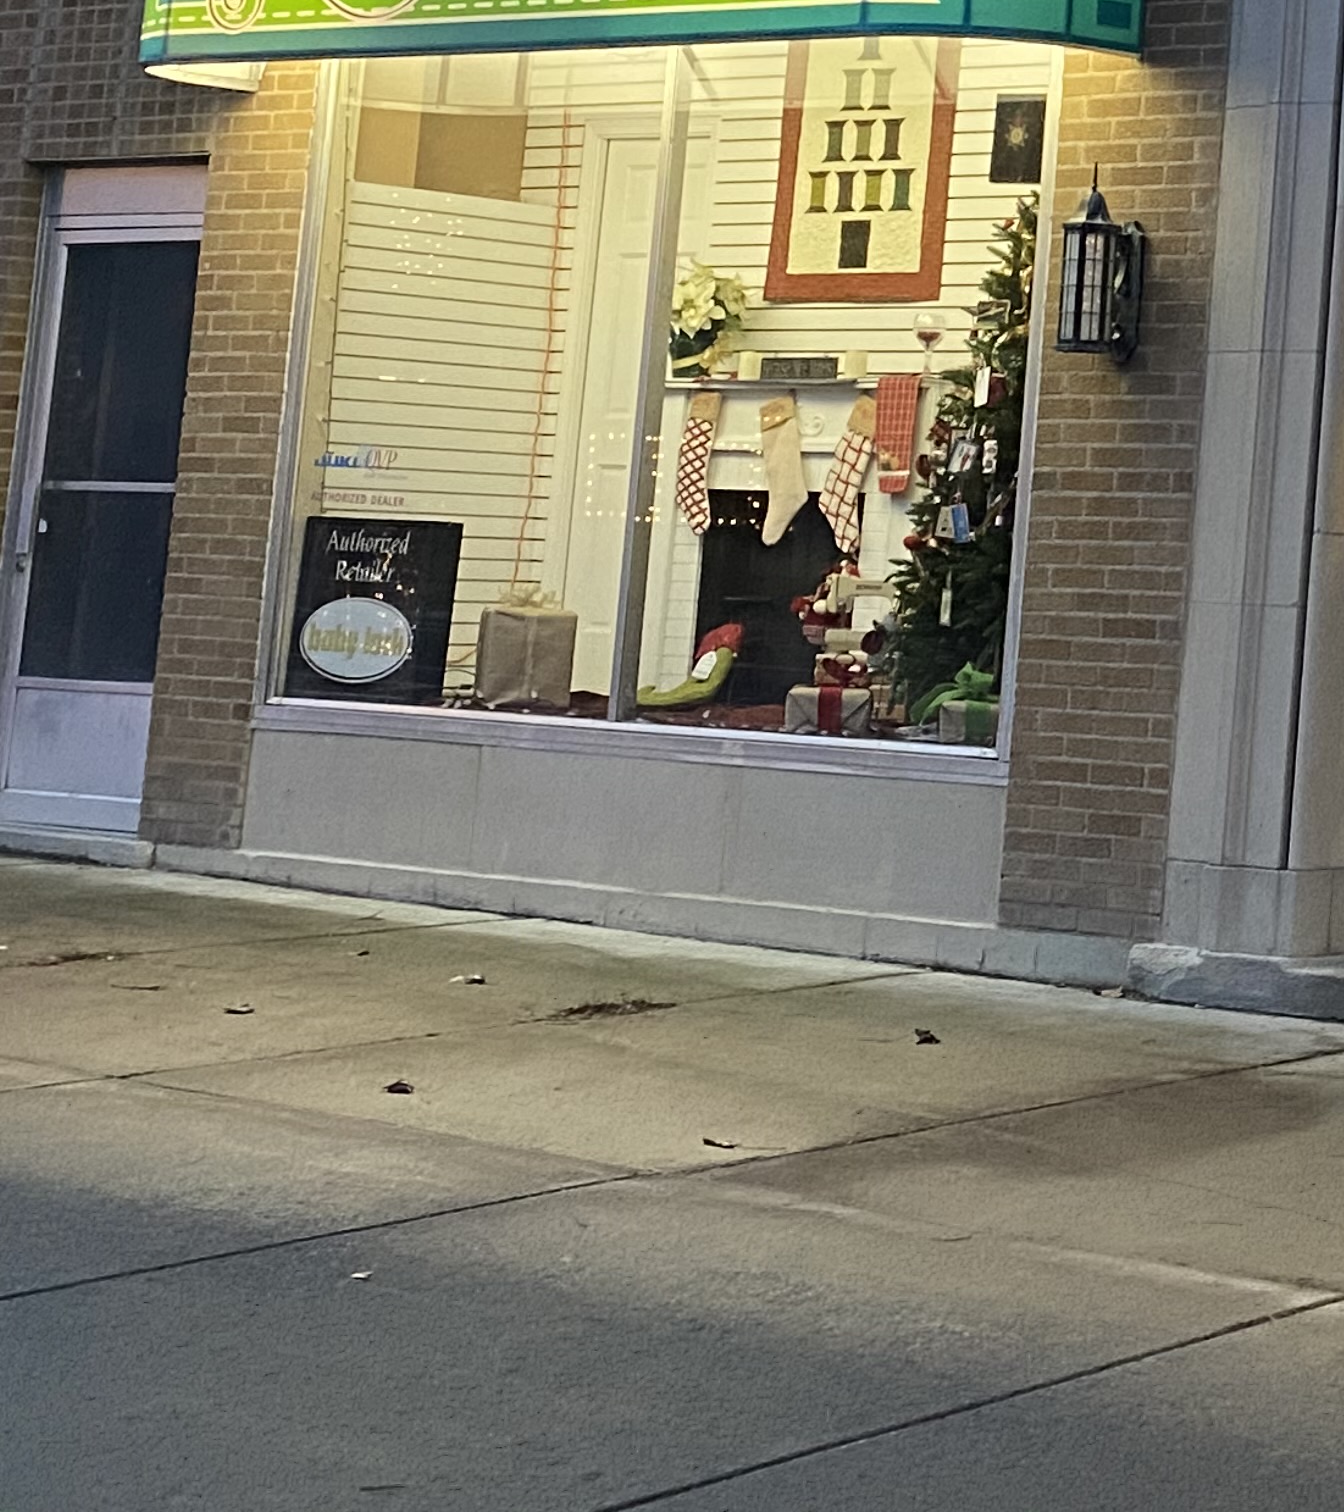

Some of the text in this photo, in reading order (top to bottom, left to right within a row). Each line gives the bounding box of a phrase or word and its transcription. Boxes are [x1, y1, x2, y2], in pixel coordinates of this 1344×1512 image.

[311, 491, 405, 507] AUTHORIZED DEALER
[326, 528, 411, 555] Authorized
[335, 560, 396, 583] Retailer
